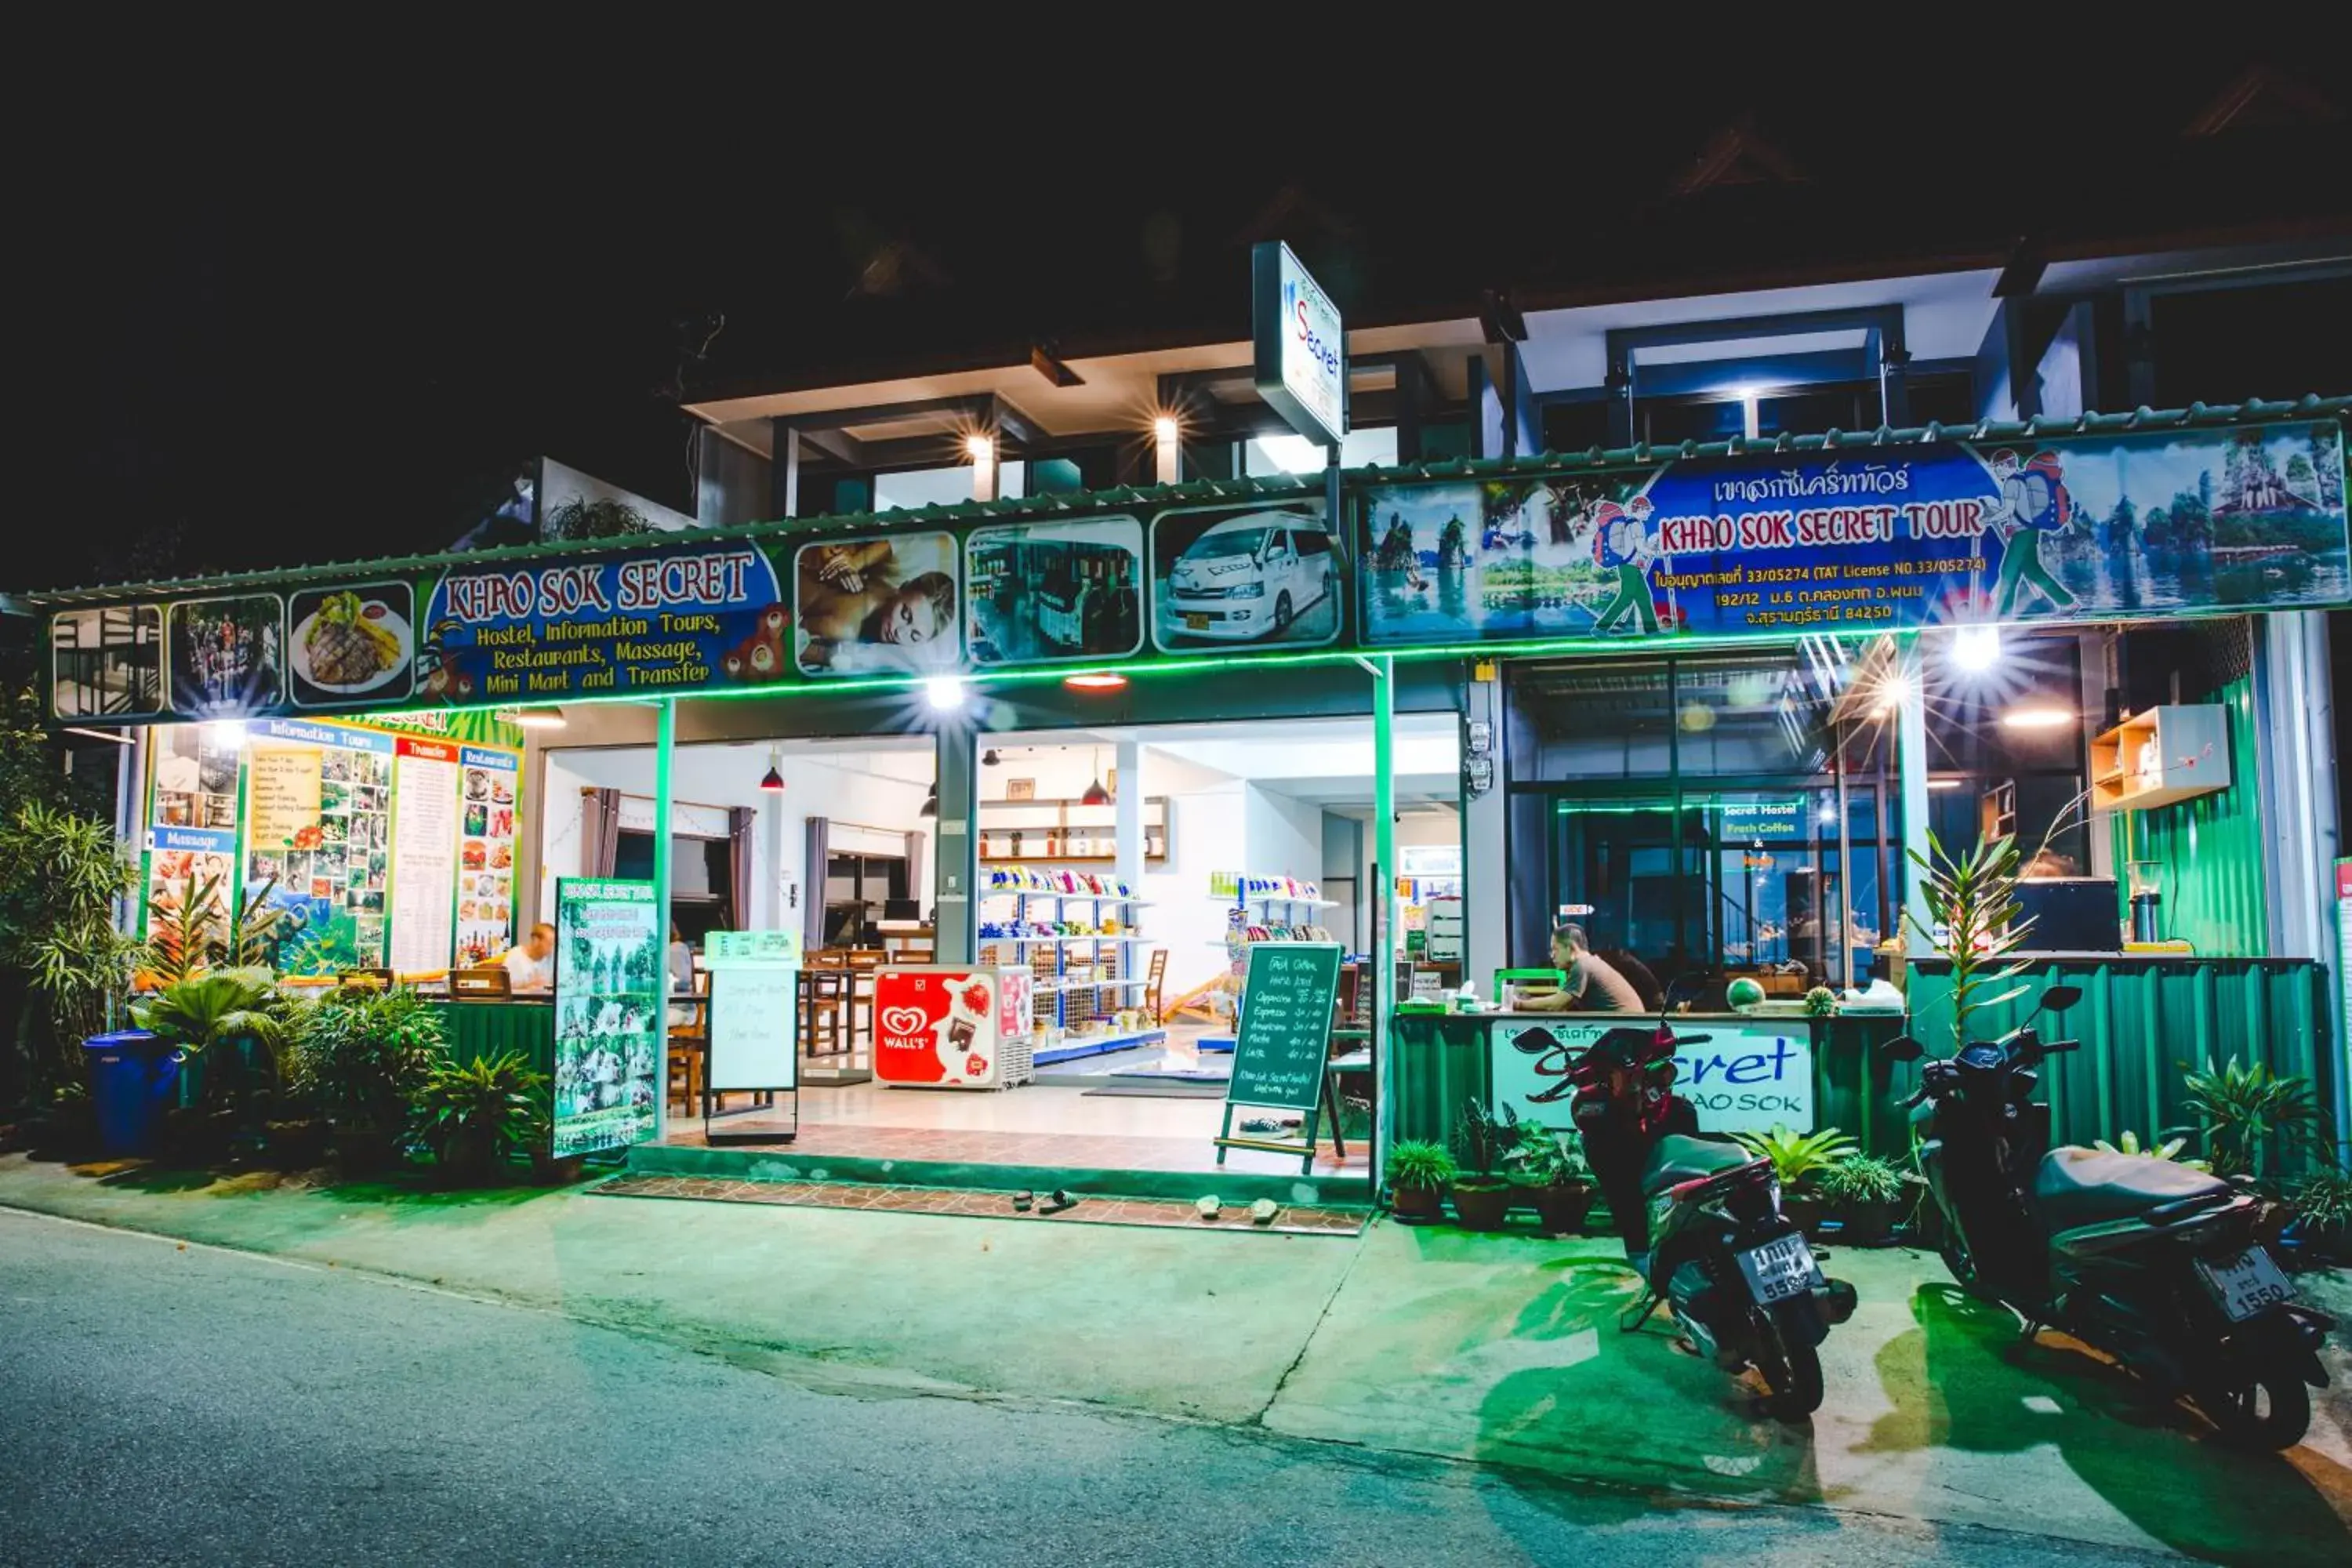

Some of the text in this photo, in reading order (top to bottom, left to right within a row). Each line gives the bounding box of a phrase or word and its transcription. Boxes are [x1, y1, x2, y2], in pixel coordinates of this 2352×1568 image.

[1298, 300, 1339, 376] Secret
[1659, 499, 1985, 554] KHAO SOK SECRET TOUR
[1748, 568, 1809, 583] 33/05274
[1844, 563, 1890, 578] License
[445, 552, 753, 622] KHAO SOK SECRET
[1715, 592, 1759, 607] 192/12
[1846, 605, 1892, 619] 84250
[477, 613, 720, 647] Hostel, Information Tours,
[494, 639, 702, 670] Restaurants, Massage,
[487, 662, 709, 693] Mini Mart and Transfer
[270, 720, 335, 742] Information
[1725, 803, 1796, 815] Secret Hostel
[1726, 822, 1795, 833] Fresh Coffee
[167, 832, 218, 849] Massage
[884, 1037, 927, 1049] WALL'S
[1737, 1093, 1802, 1112] SOK
